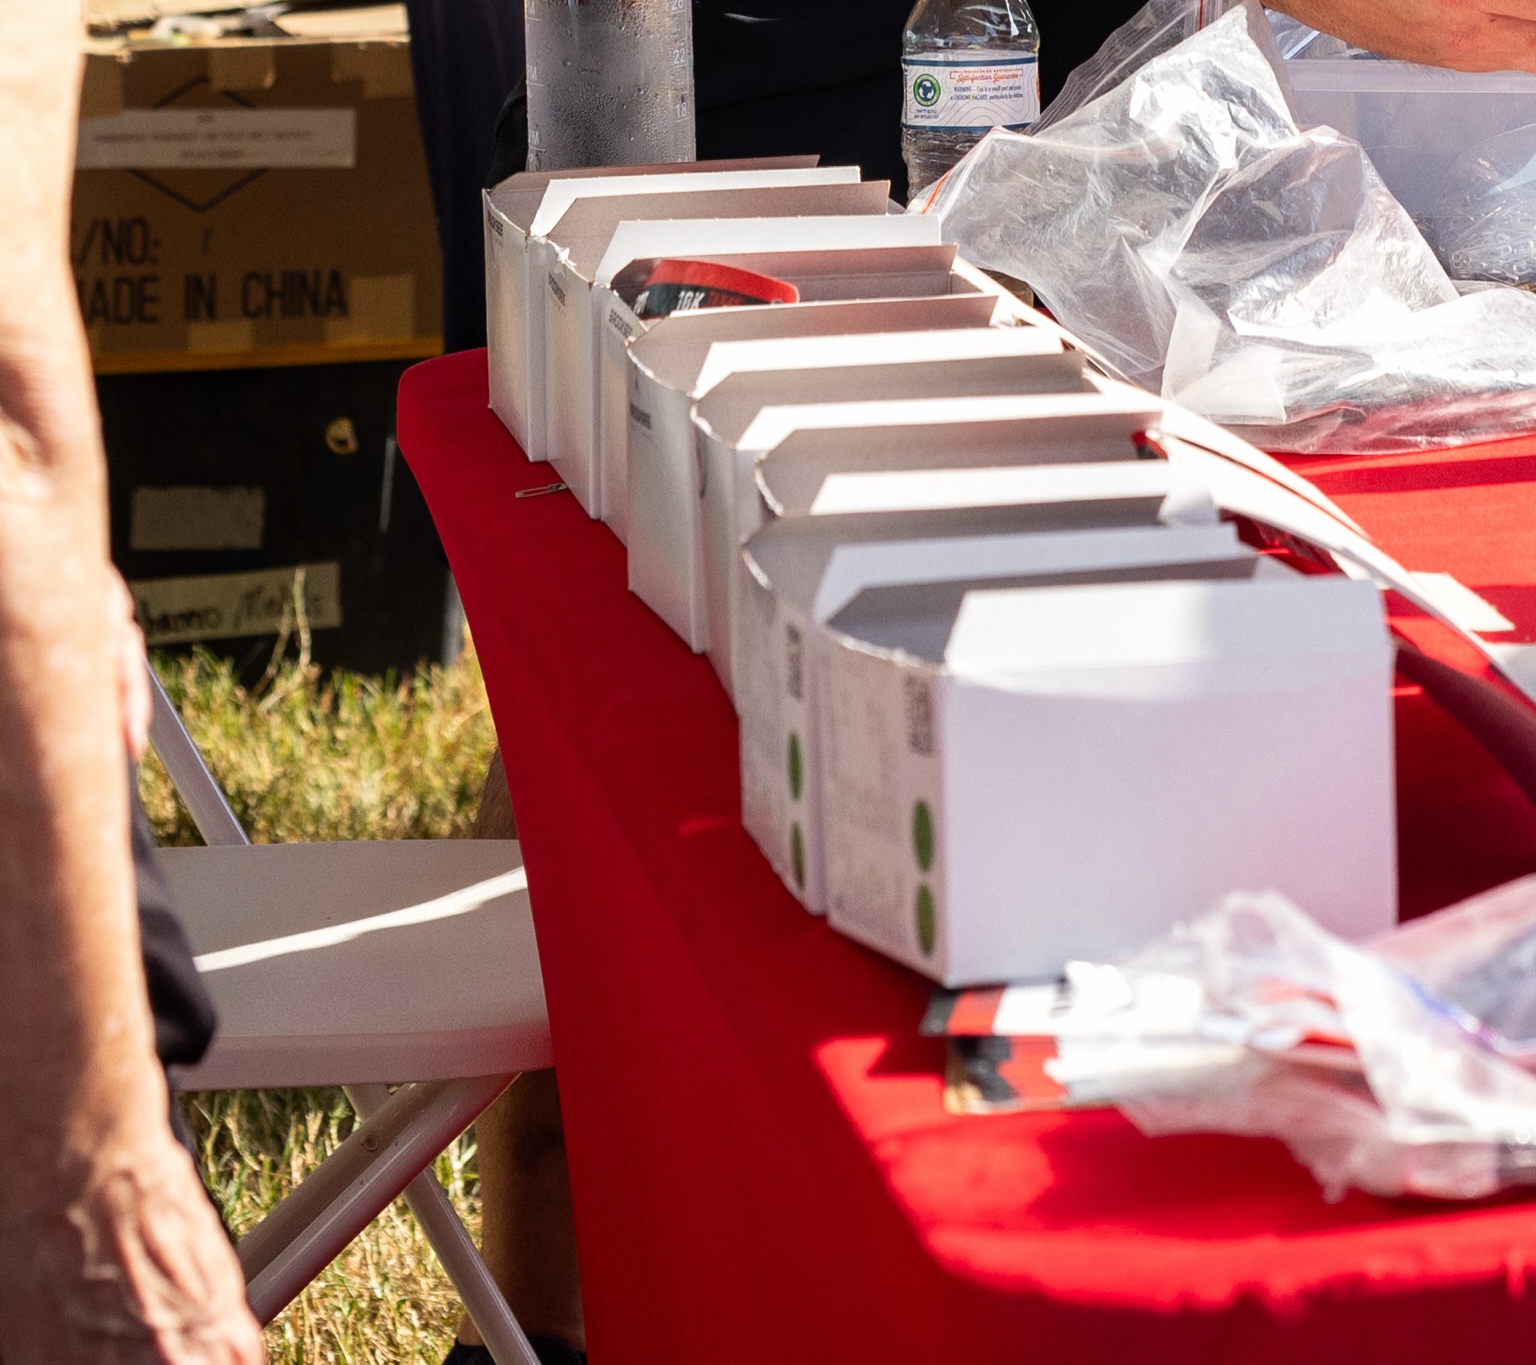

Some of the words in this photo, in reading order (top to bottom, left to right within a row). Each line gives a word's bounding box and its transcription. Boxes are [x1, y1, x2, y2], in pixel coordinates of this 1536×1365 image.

[673, 48, 686, 65] 22
[675, 101, 688, 118] 18
[183, 273, 217, 322] IN
[240, 269, 349, 319] CHINA
